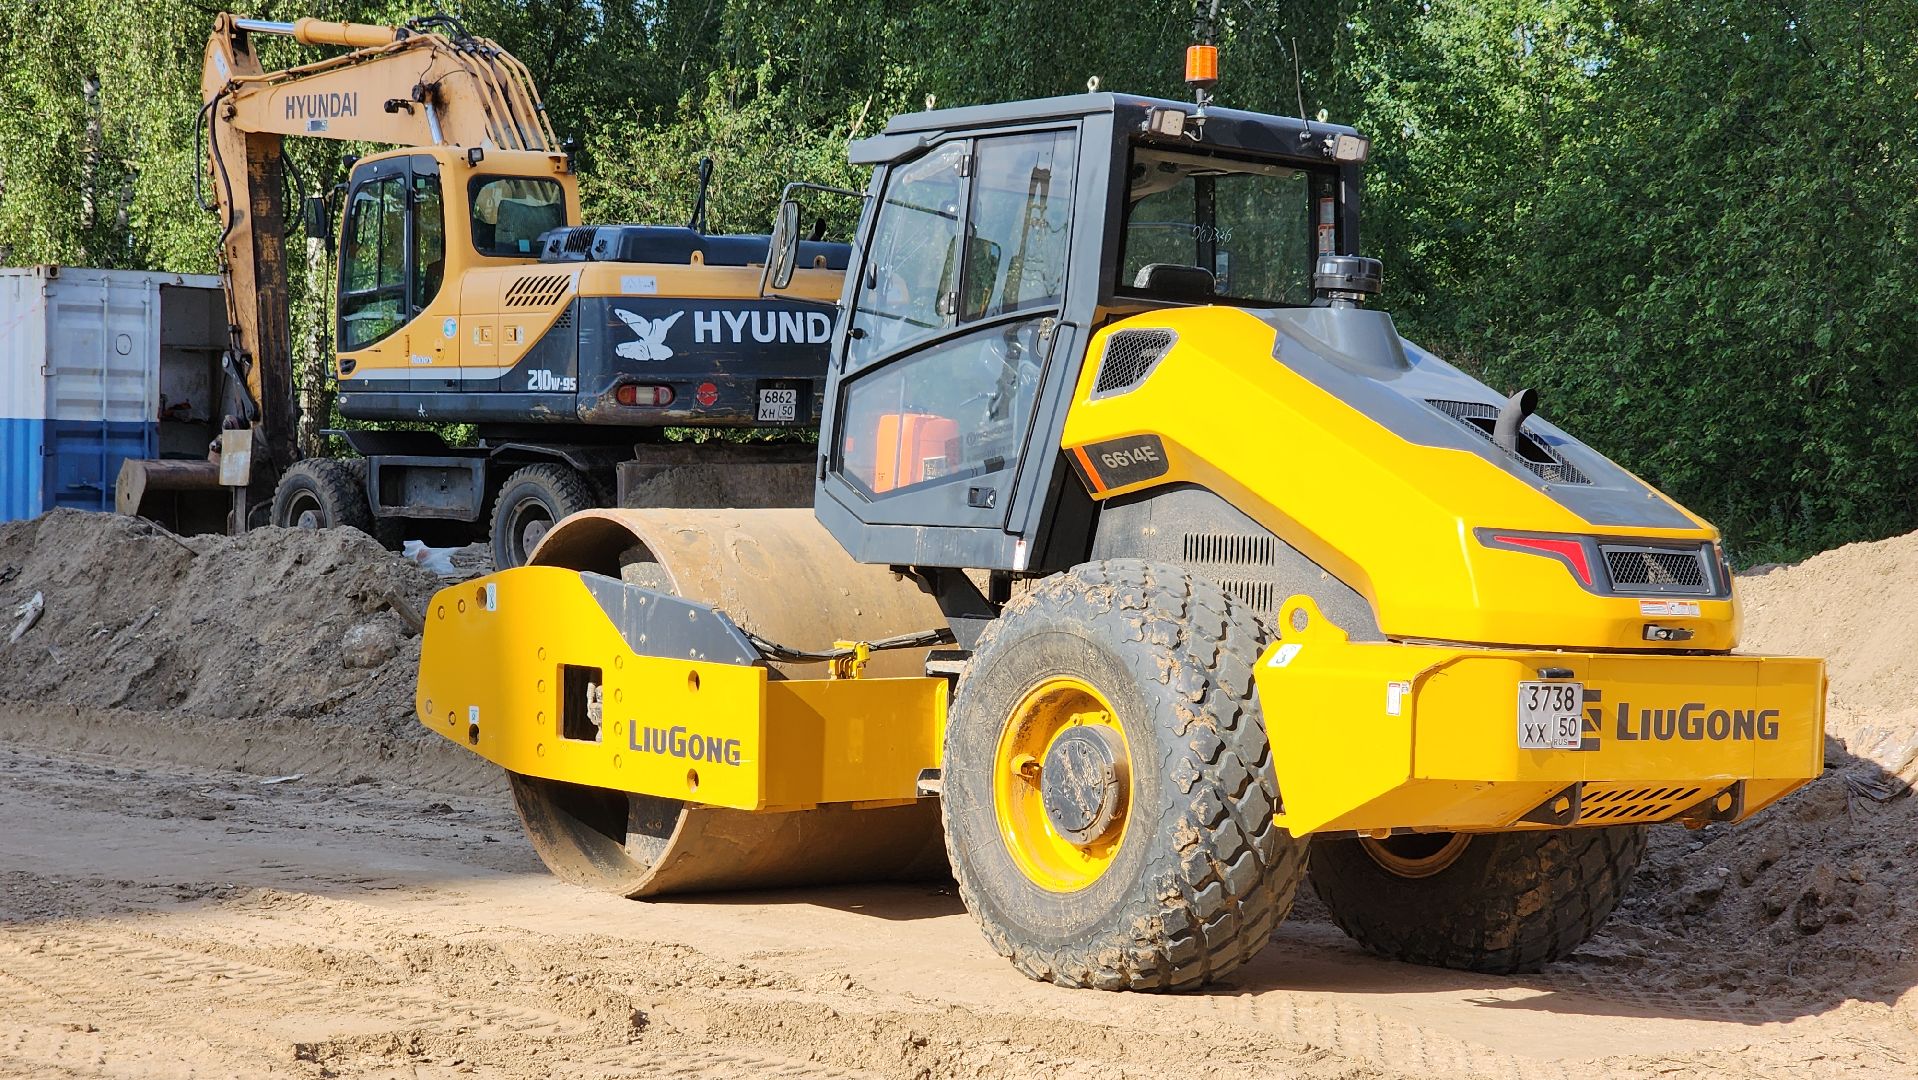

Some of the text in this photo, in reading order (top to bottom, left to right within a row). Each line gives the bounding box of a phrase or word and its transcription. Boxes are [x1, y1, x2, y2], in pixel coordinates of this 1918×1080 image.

[285, 92, 357, 119] HYUNDAI
[694, 310, 831, 343] HYUND
[764, 391, 792, 403] 6862
[781, 406, 793, 415] 50
[1101, 445, 1160, 469] 6614E
[1528, 686, 1574, 711] 3738
[1558, 717, 1577, 737] 50
[1553, 738, 1568, 746] RUS
